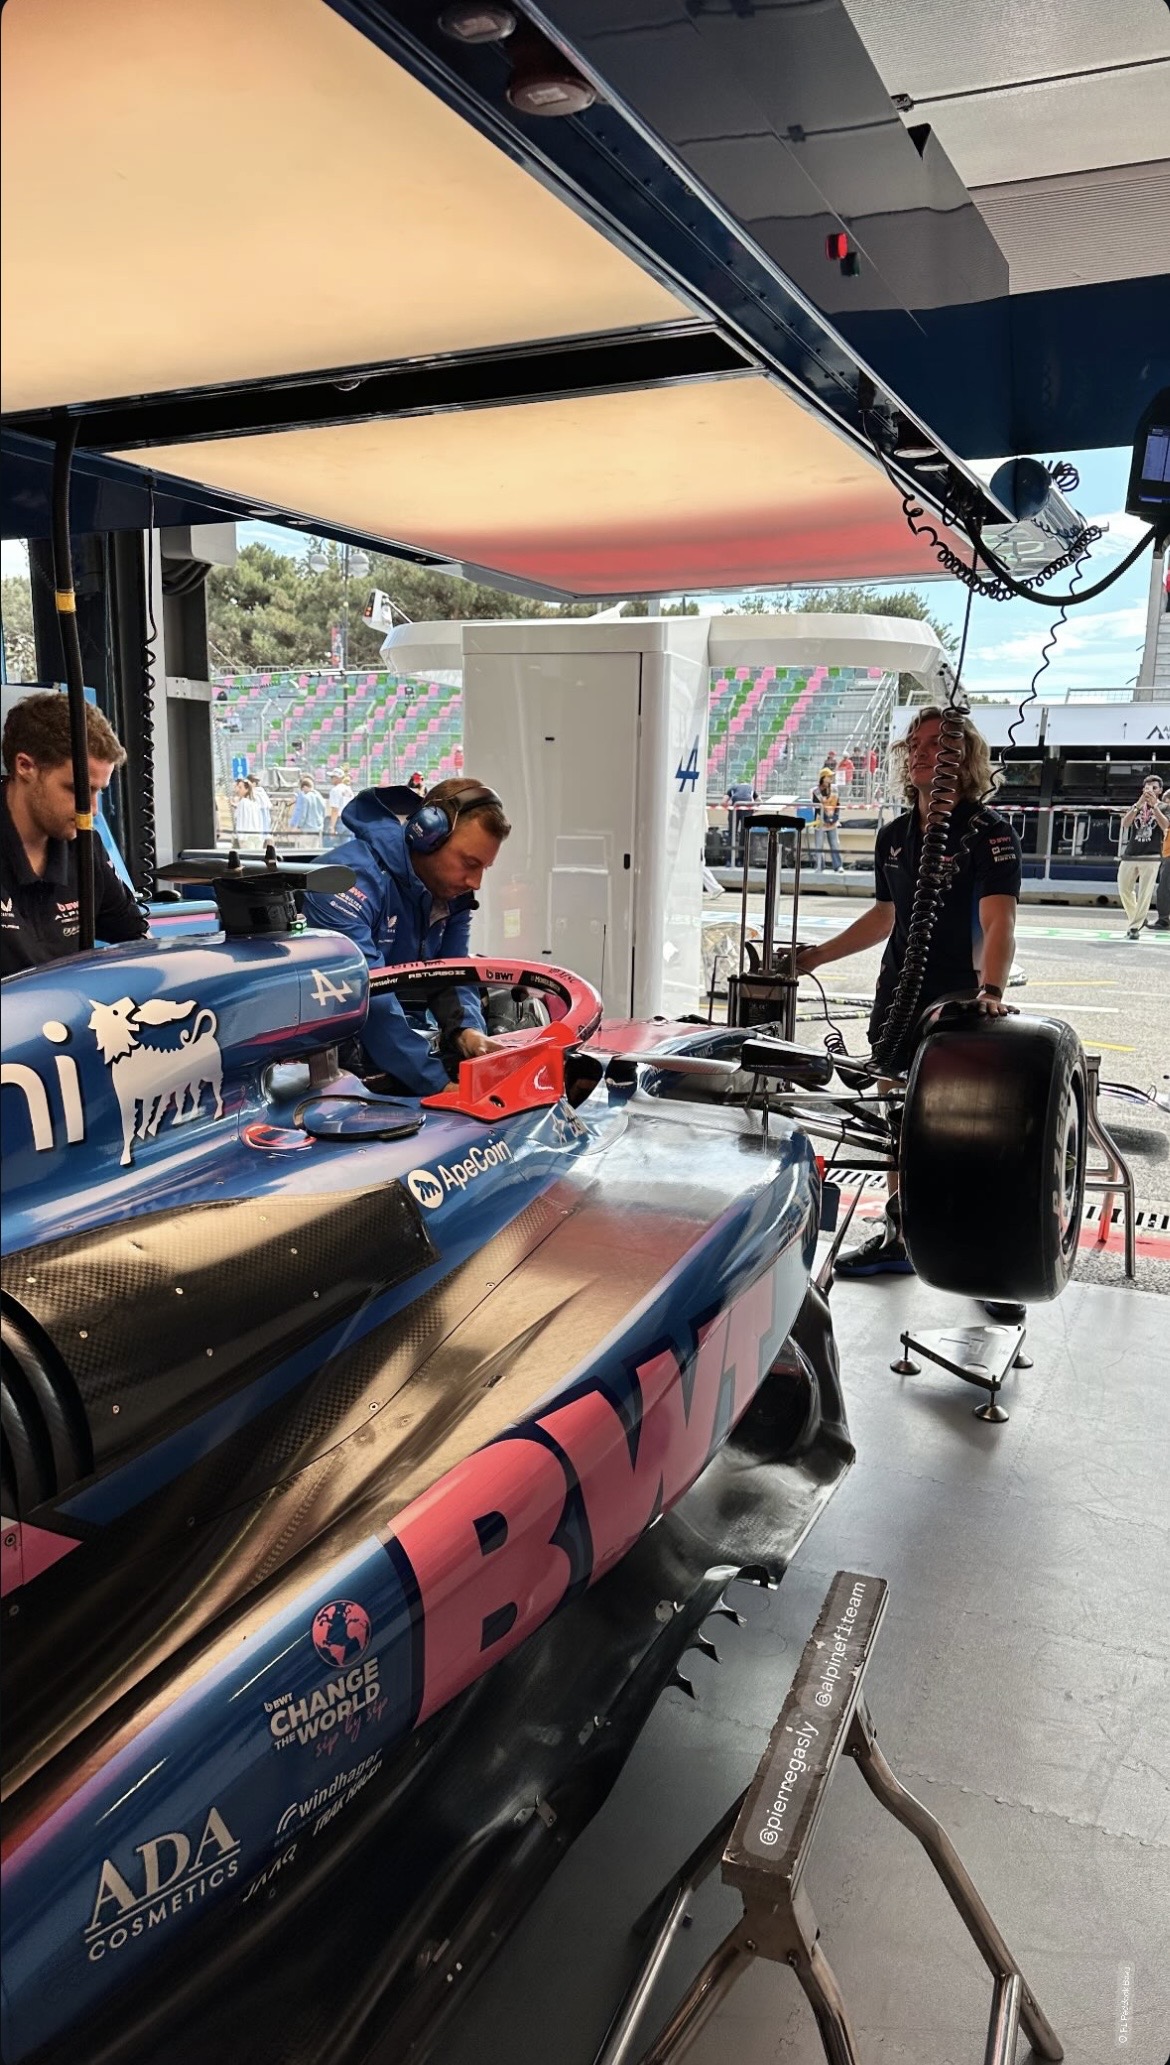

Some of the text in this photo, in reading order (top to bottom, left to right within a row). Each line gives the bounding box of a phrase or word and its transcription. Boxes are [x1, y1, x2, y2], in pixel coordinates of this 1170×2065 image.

[495, 972, 514, 981] BWT
[438, 1139, 514, 1191] ApeCoin
[387, 1268, 776, 1729] BWT
[270, 1656, 380, 1737] CHANGE
[274, 1692, 293, 1708] BWT
[274, 1682, 381, 1750] THE WORLD
[299, 1748, 383, 1818] windhager
[85, 1806, 241, 1934] ADA
[88, 1858, 240, 1962] COSMETICS
